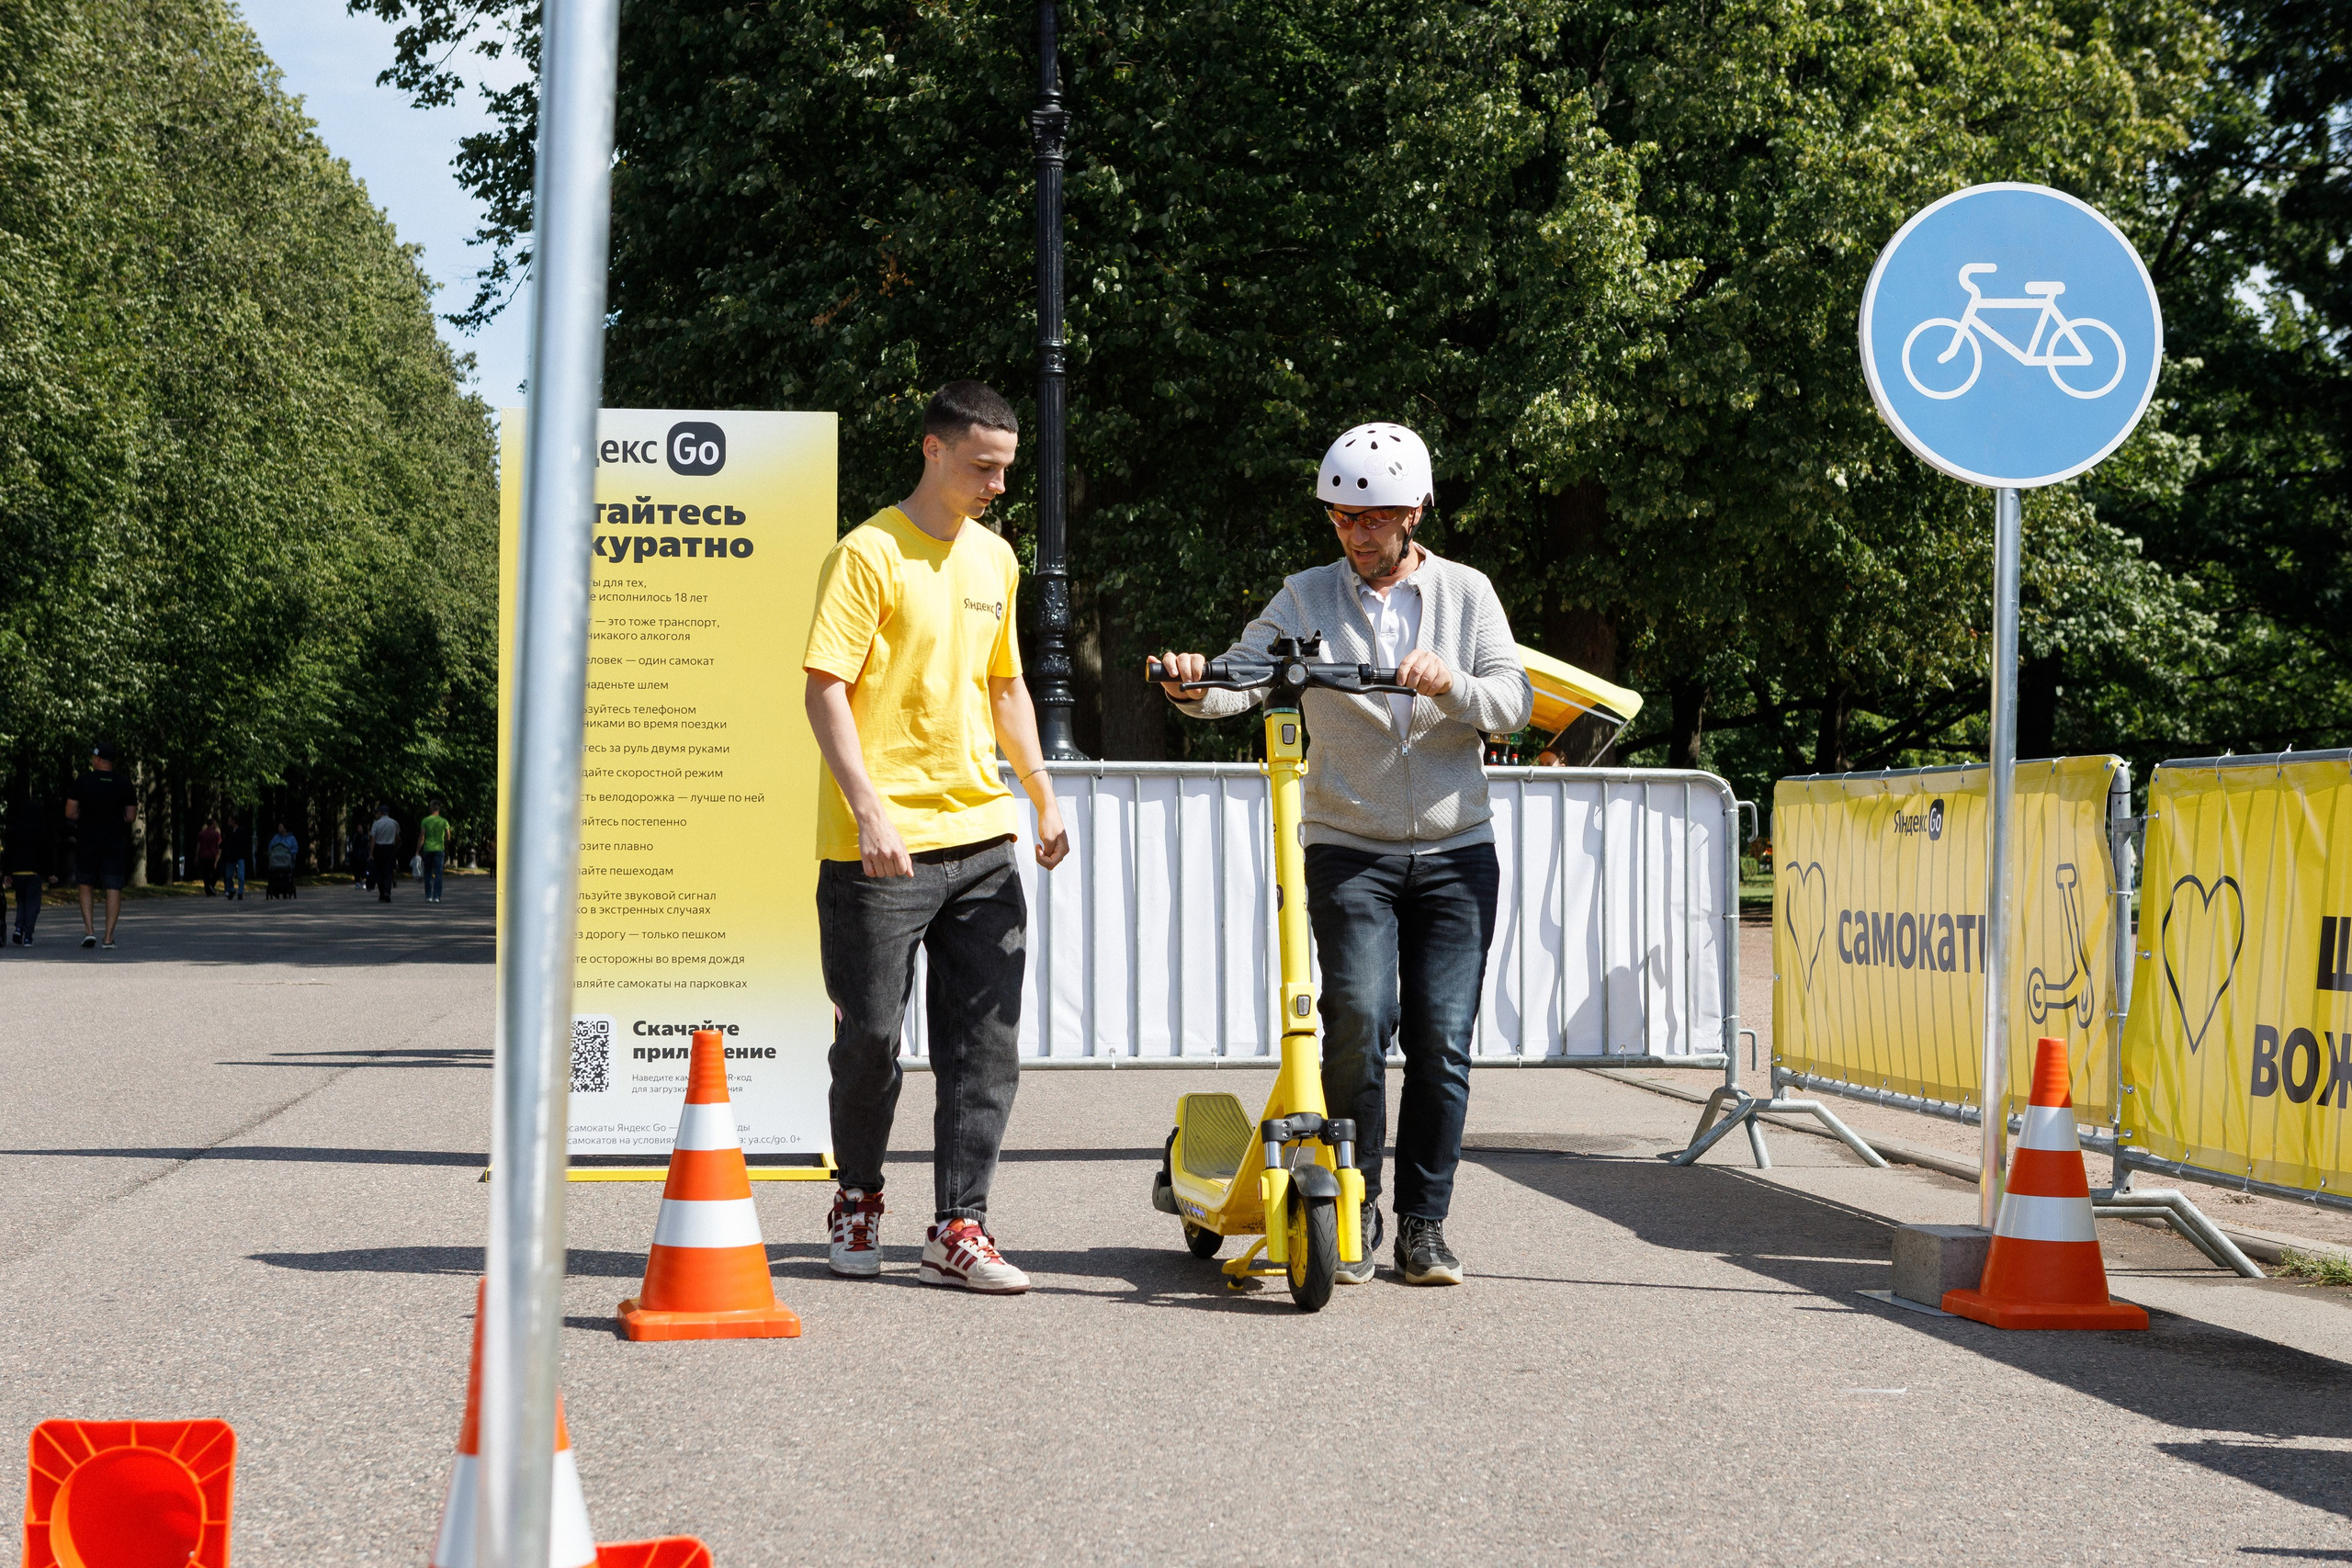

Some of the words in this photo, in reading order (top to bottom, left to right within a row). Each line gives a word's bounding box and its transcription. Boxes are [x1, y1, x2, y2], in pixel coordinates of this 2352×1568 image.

[673, 433, 719, 465] Go
[604, 579, 622, 588] для
[627, 580, 646, 588] тех,
[599, 593, 671, 602] исполнилось
[674, 593, 687, 602] 18
[690, 594, 707, 603] лет
[964, 598, 995, 614] Яндекс
[608, 618, 626, 626] это
[629, 618, 656, 626] тоже
[659, 619, 719, 628] транспорт,
[639, 657, 666, 667] один
[634, 705, 696, 716] телефоном
[628, 720, 640, 728] во
[643, 720, 678, 730] время
[681, 720, 727, 730] поездки
[609, 744, 621, 752] за
[623, 744, 649, 755] руль
[651, 744, 685, 755] двумя
[688, 745, 729, 755] руками
[616, 768, 682, 779] скоростной
[684, 769, 723, 780] режим
[599, 794, 674, 804] велодорожка
[691, 794, 726, 805] лучше
[745, 793, 764, 803] ней
[622, 818, 686, 827] постепенно
[1894, 809, 1928, 836] Яндекс
[1929, 807, 1942, 832] Go
[610, 867, 673, 877] пешеходам
[625, 891, 675, 903] звуковой
[678, 892, 716, 900] сигнал
[599, 907, 663, 916] экстренных
[667, 907, 711, 916] случаях
[586, 931, 626, 941] дорогу
[642, 931, 679, 939] только
[682, 931, 726, 939] пешком
[590, 955, 652, 964] осторожны
[672, 956, 706, 965] время
[708, 956, 745, 965] дождя
[617, 980, 671, 988] самокаты
[674, 980, 686, 988] на
[689, 980, 747, 990] парковках
[633, 1046, 776, 1062] приление
[632, 1074, 673, 1083] Наведите
[617, 1123, 650, 1133] Яндекс
[653, 1123, 666, 1132] Go
